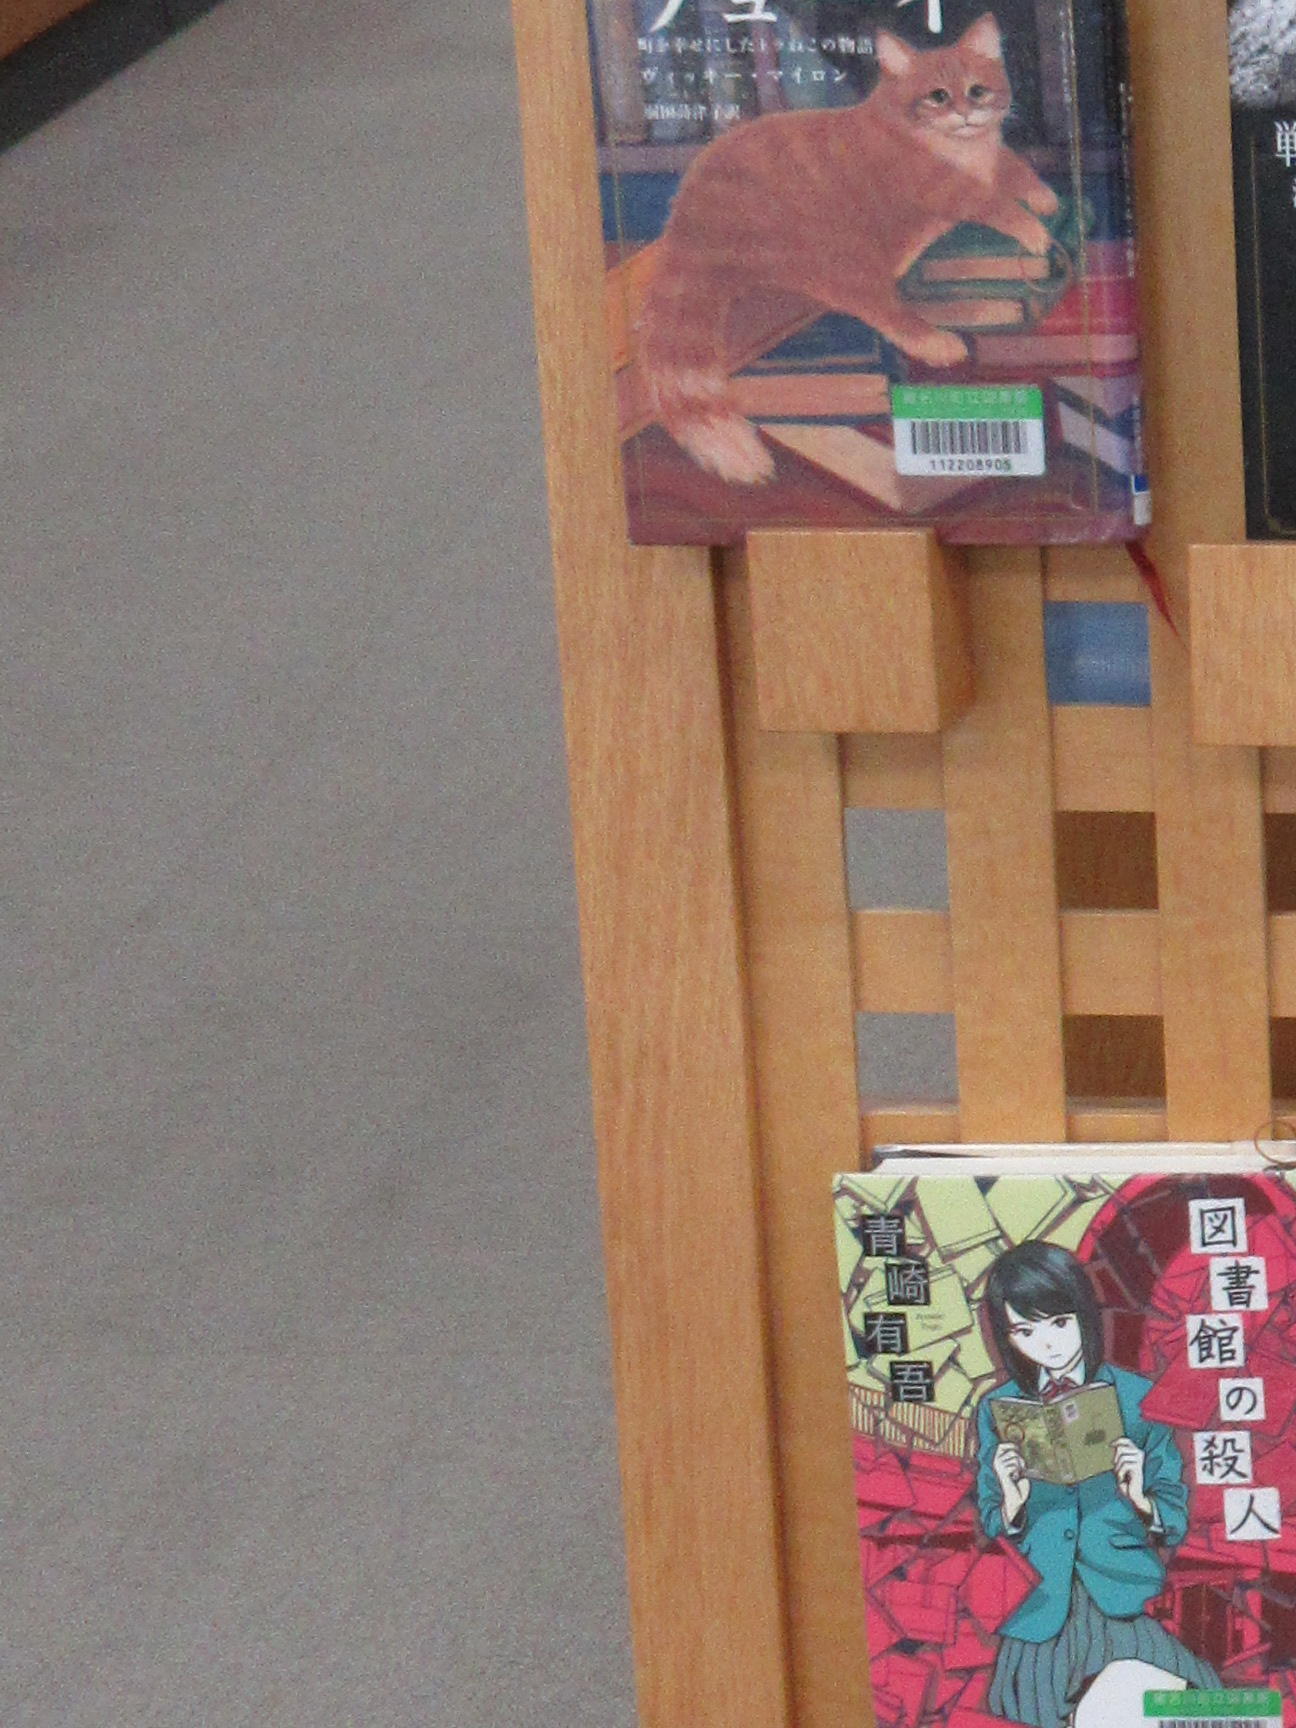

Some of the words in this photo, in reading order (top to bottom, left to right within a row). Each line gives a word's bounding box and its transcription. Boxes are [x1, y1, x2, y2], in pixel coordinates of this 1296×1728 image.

[864, 1216, 933, 1400] 青崎有吾
[1190, 1205, 1279, 1537] 図書館の殺人
